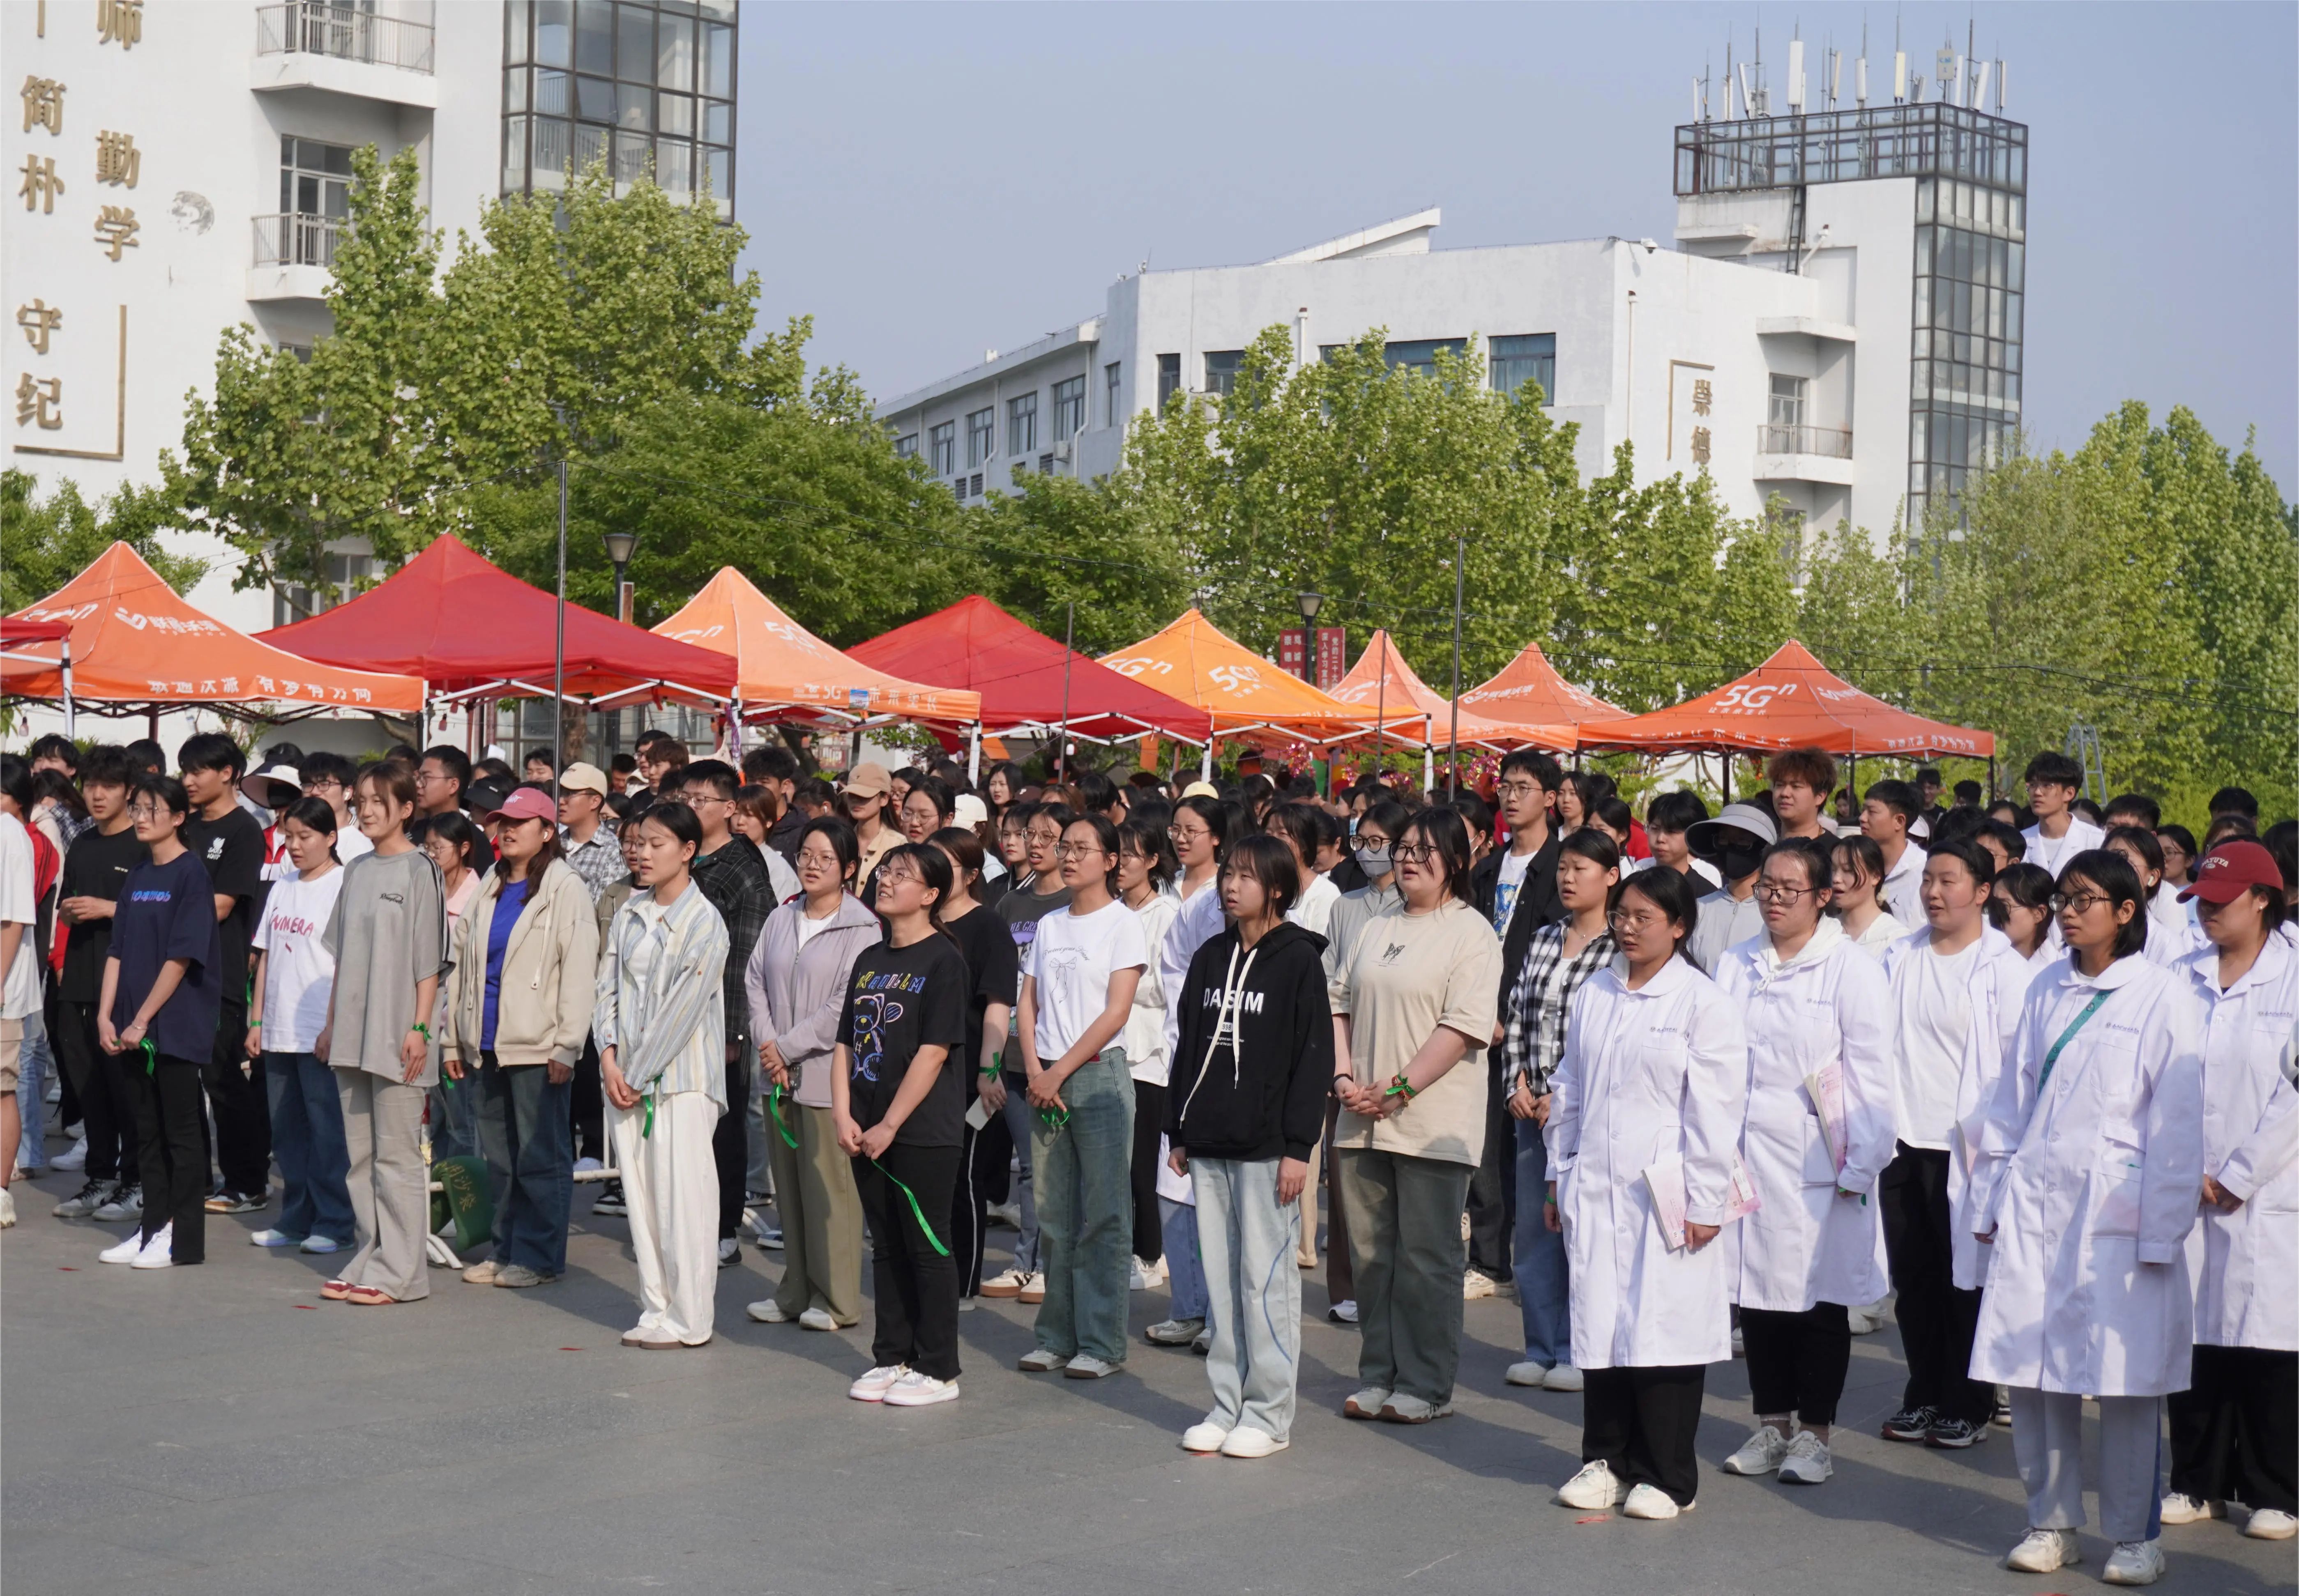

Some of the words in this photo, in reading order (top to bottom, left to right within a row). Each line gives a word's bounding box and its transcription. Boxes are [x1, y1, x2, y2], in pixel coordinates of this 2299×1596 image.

[18, 75, 67, 214] 简朴
[94, 130, 141, 262] 勤学
[15, 298, 63, 430] 守纪
[1691, 379, 1712, 465] 崇德
